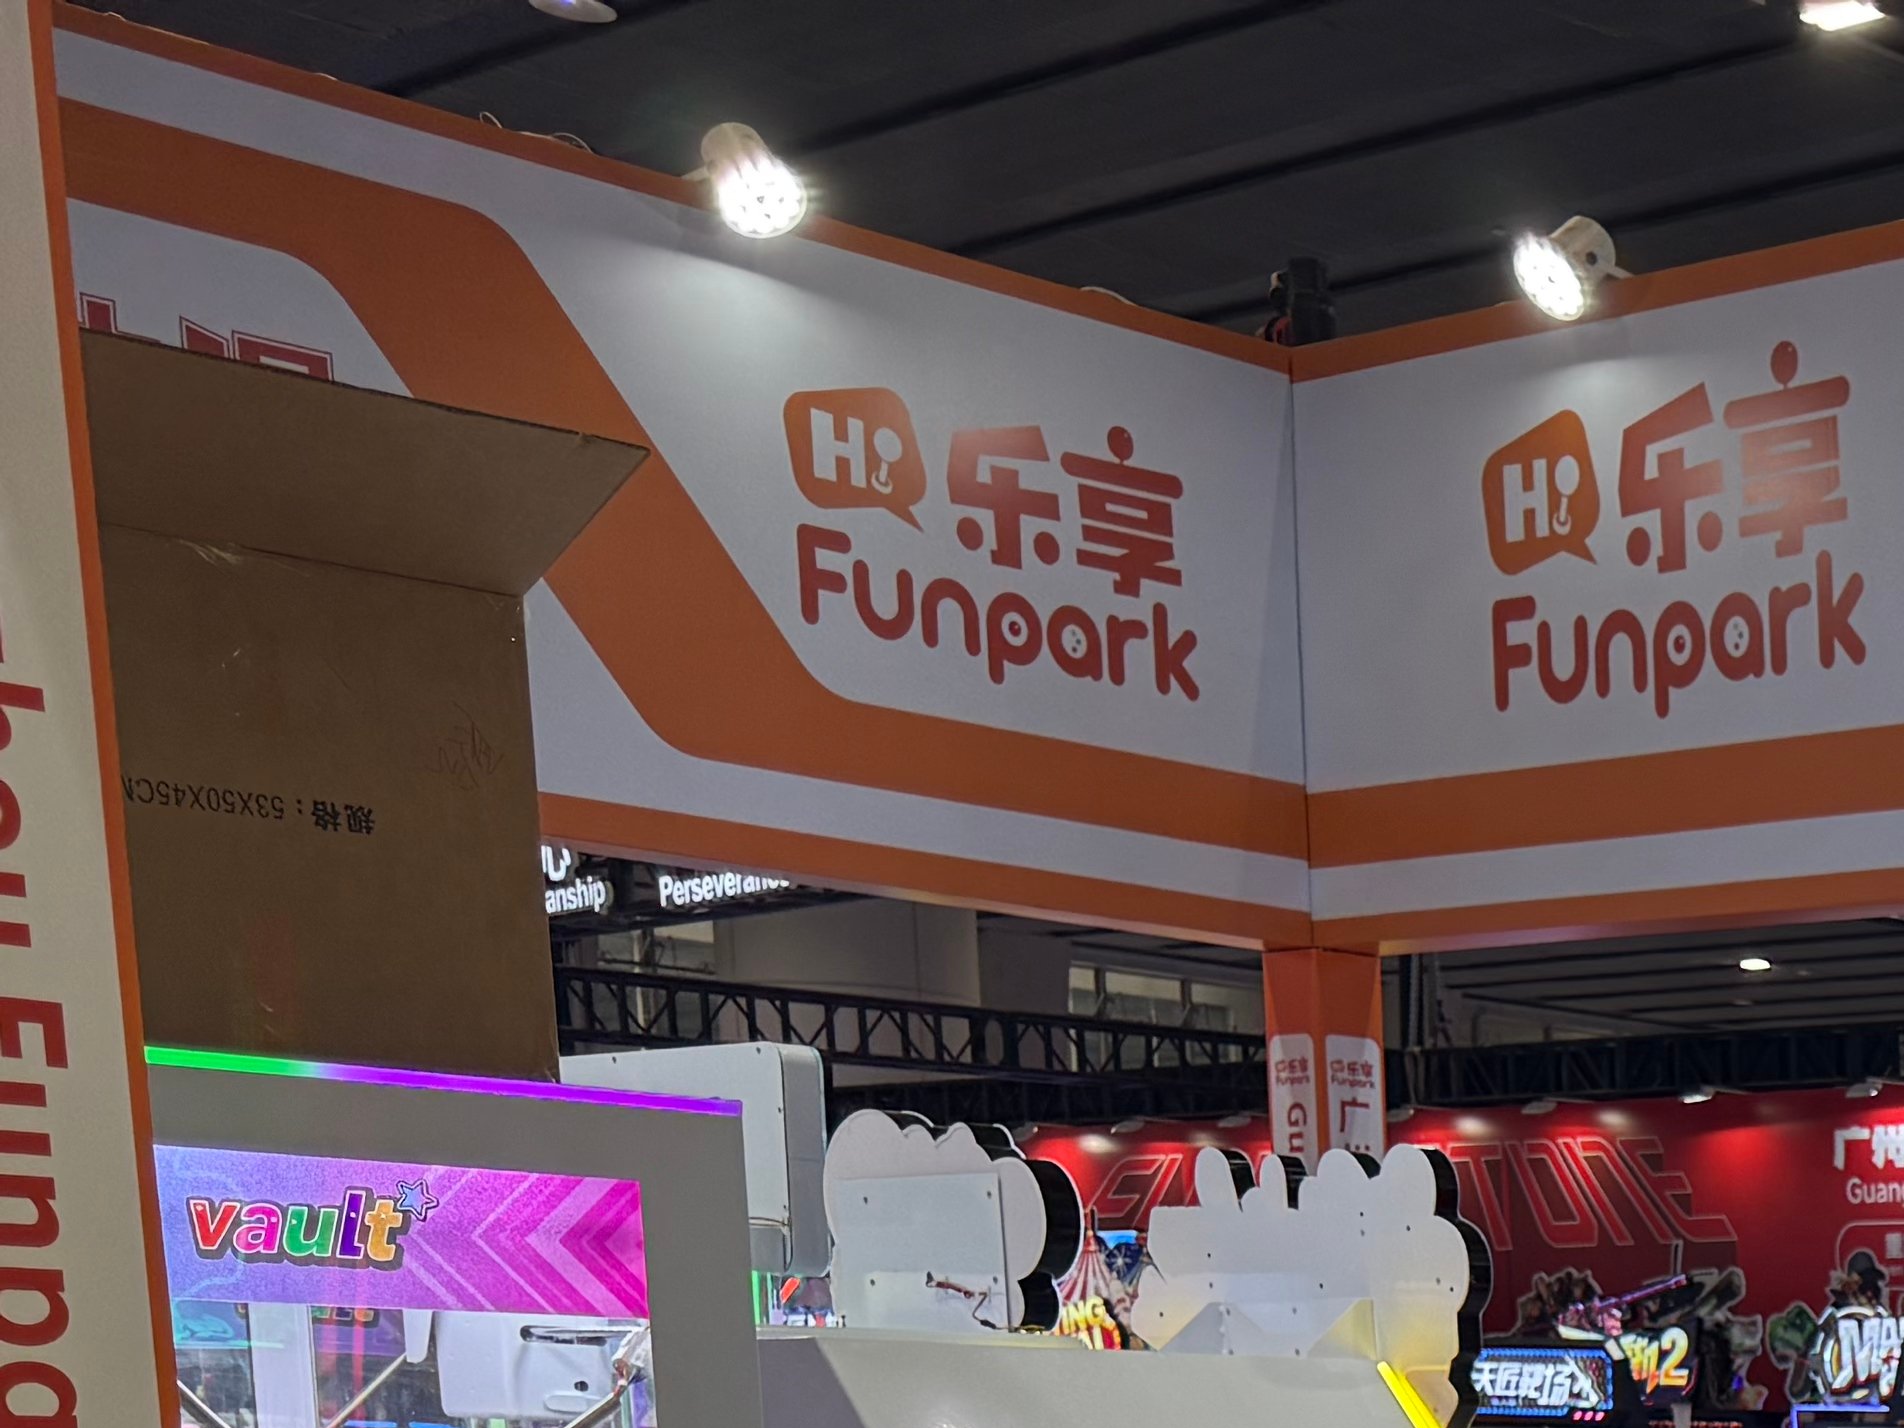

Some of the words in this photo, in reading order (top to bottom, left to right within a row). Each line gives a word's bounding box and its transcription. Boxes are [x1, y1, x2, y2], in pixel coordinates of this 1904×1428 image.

[946, 424, 1186, 598] 乐享
[1617, 340, 1852, 575] 乐享
[796, 521, 1202, 704] Funpark
[1491, 549, 1868, 720] Funpark
[188, 1186, 405, 1264] vault
